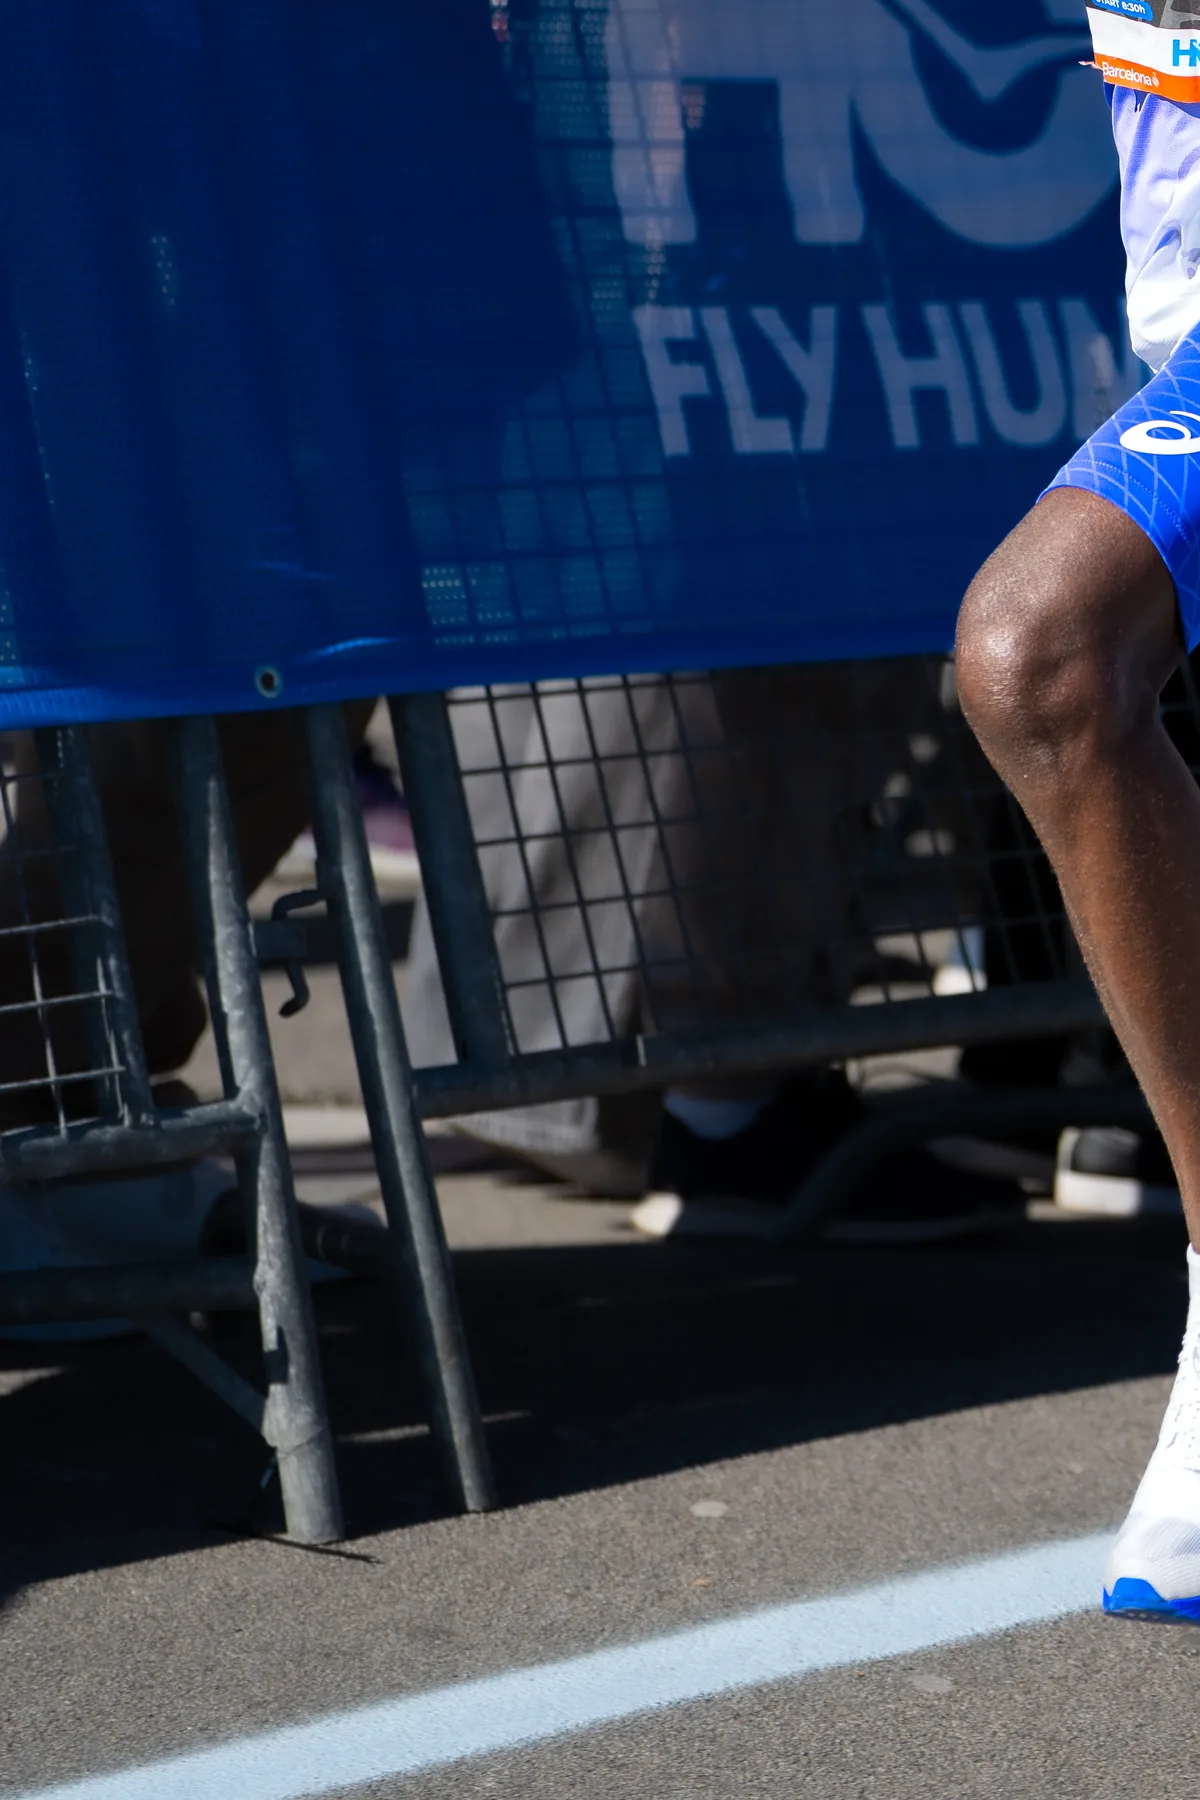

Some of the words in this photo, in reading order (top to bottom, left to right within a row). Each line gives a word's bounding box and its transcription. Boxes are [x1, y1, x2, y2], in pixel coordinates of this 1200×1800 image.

[1121, 1, 1146, 15] 8:30h
[1102, 61, 1152, 87] Barcelona
[632, 303, 837, 456] FLY
